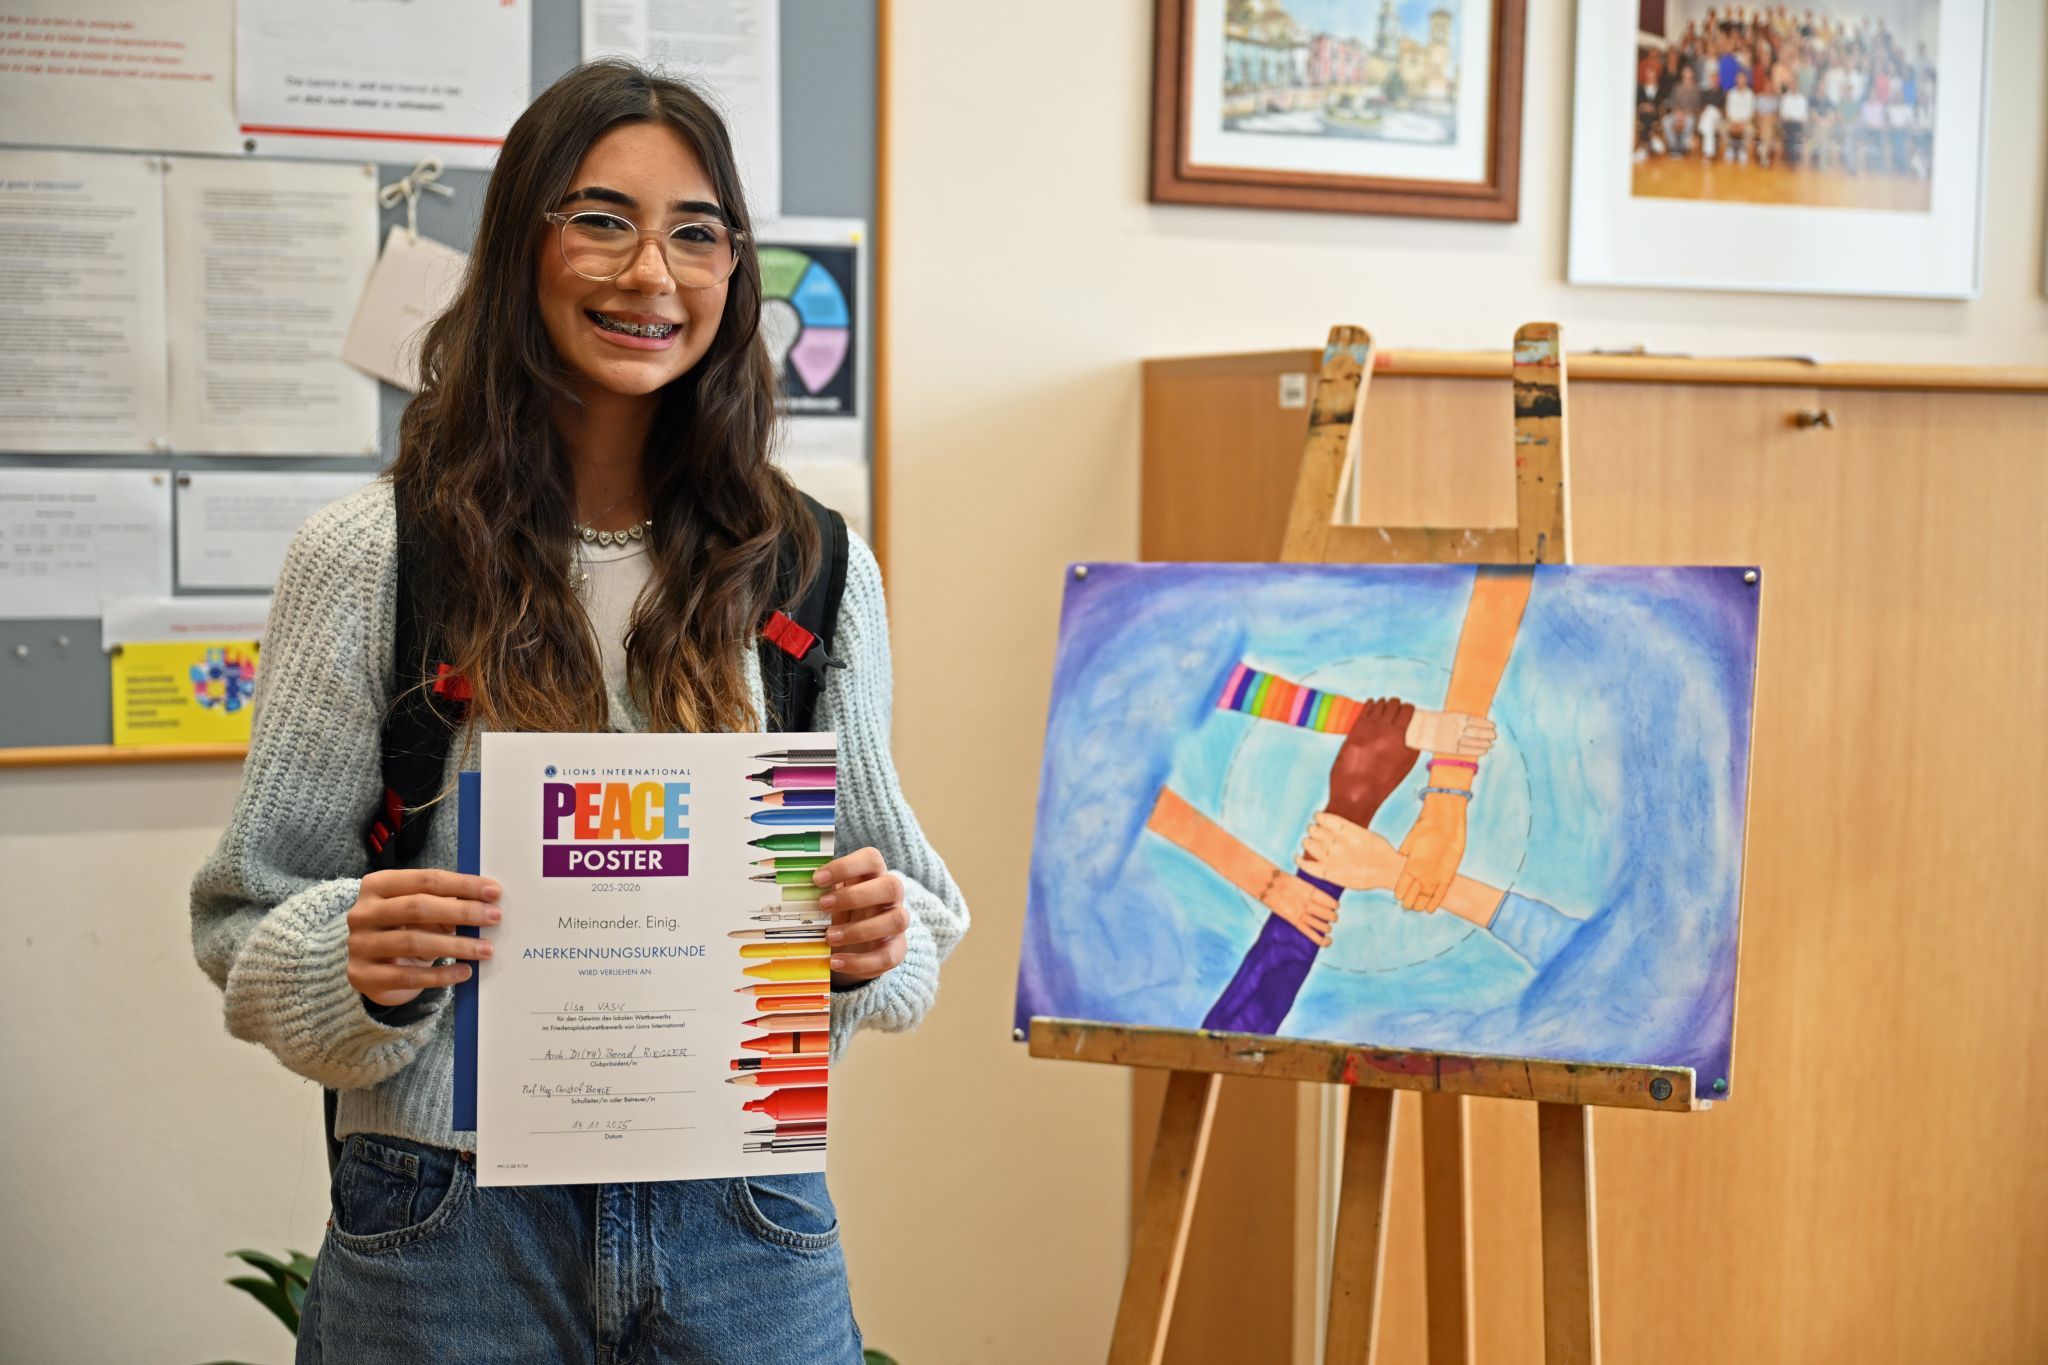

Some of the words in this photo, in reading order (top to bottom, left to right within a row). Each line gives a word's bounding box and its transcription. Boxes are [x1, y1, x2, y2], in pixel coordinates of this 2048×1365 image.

[562, 768, 596, 776] LIONS
[601, 768, 691, 776] INTERNATIONAL
[543, 782, 690, 840] PEACE
[569, 850, 663, 871] POSTER
[591, 883, 641, 892] 2025-2026
[558, 916, 641, 929] Miteinander.
[646, 915, 680, 931] Einig.
[523, 945, 706, 959] ANERKENNUNGSURKUNDE
[600, 968, 638, 976] VERLIEHEN
[563, 1002, 585, 1012] Lisa
[550, 1024, 624, 1032] Friedensplakatwettbewerb
[590, 1060, 637, 1068] Clubpräsident/in
[571, 1096, 608, 1104] Schulleiter/in
